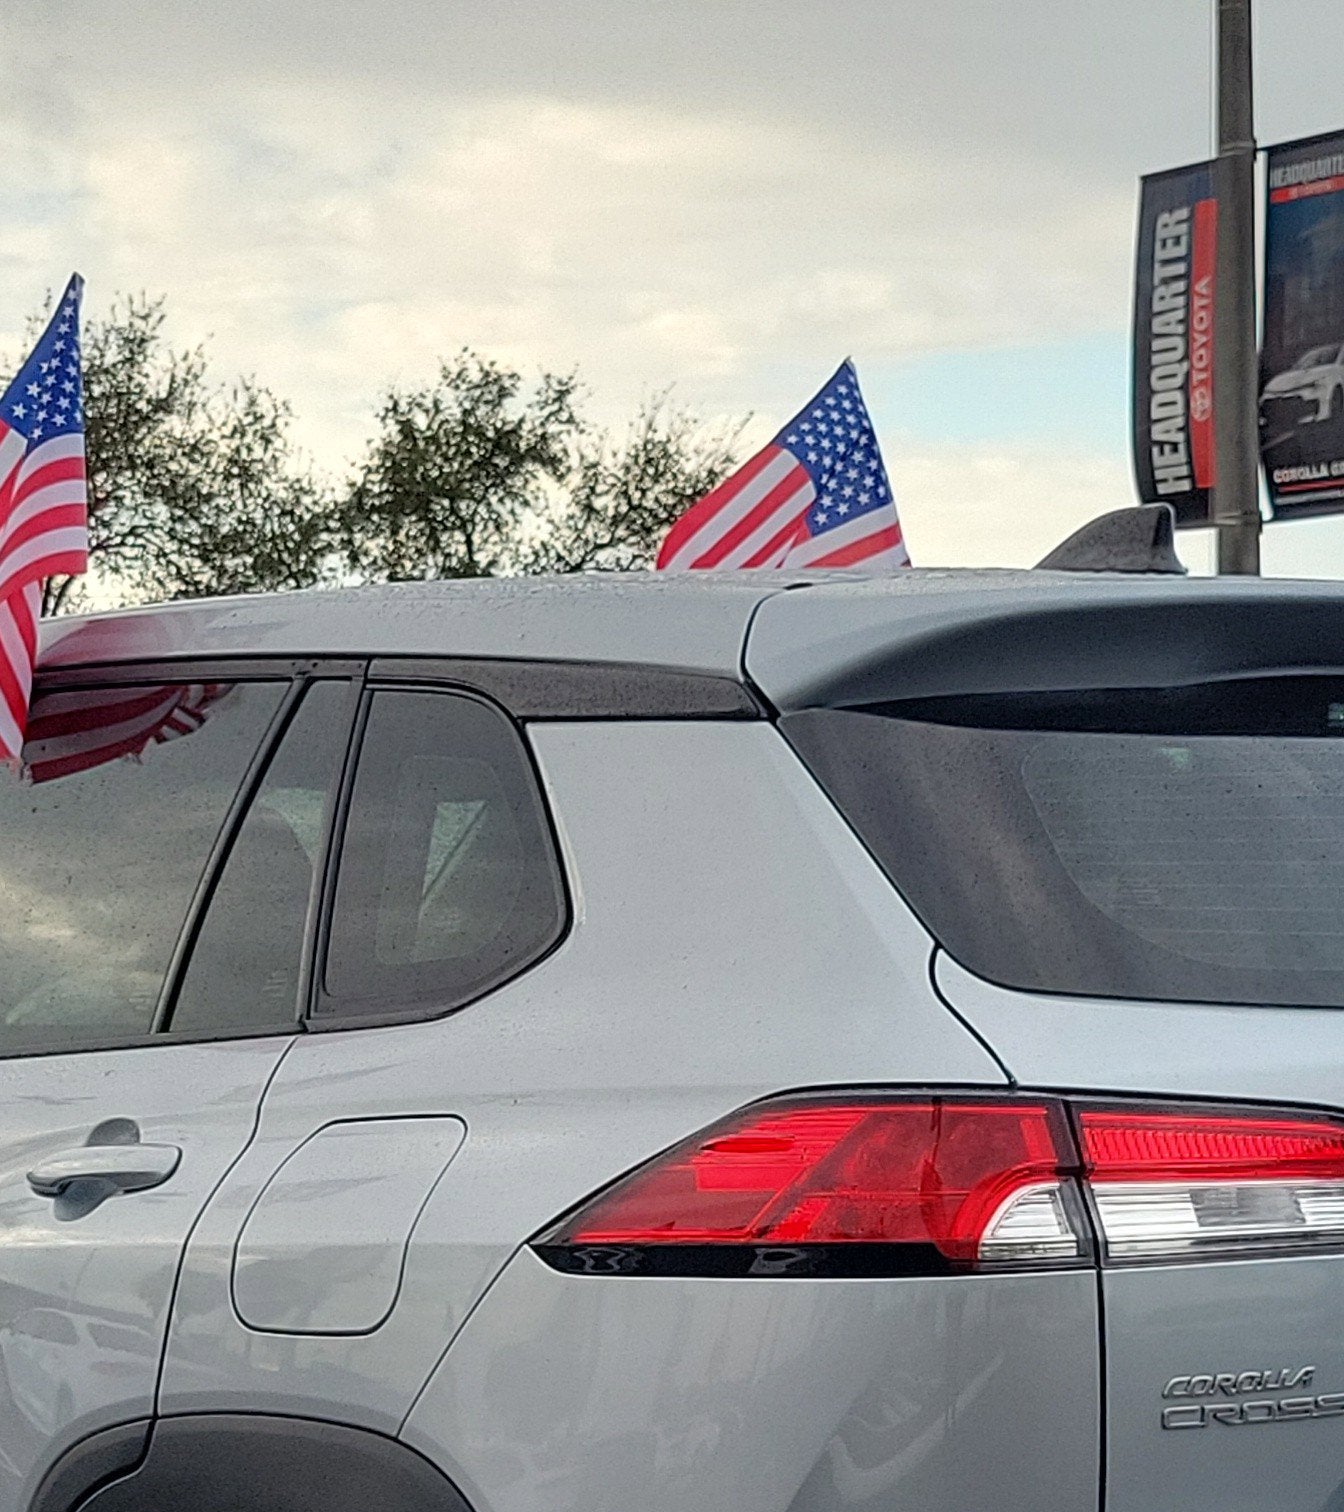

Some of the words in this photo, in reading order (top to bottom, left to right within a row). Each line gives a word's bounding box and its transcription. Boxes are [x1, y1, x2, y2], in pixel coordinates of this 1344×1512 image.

[1150, 206, 1193, 496] HEADQUARTER
[1192, 275, 1213, 385] TOYOTA
[1272, 462, 1330, 484] COROLLA
[1162, 1365, 1316, 1399] COROLLA
